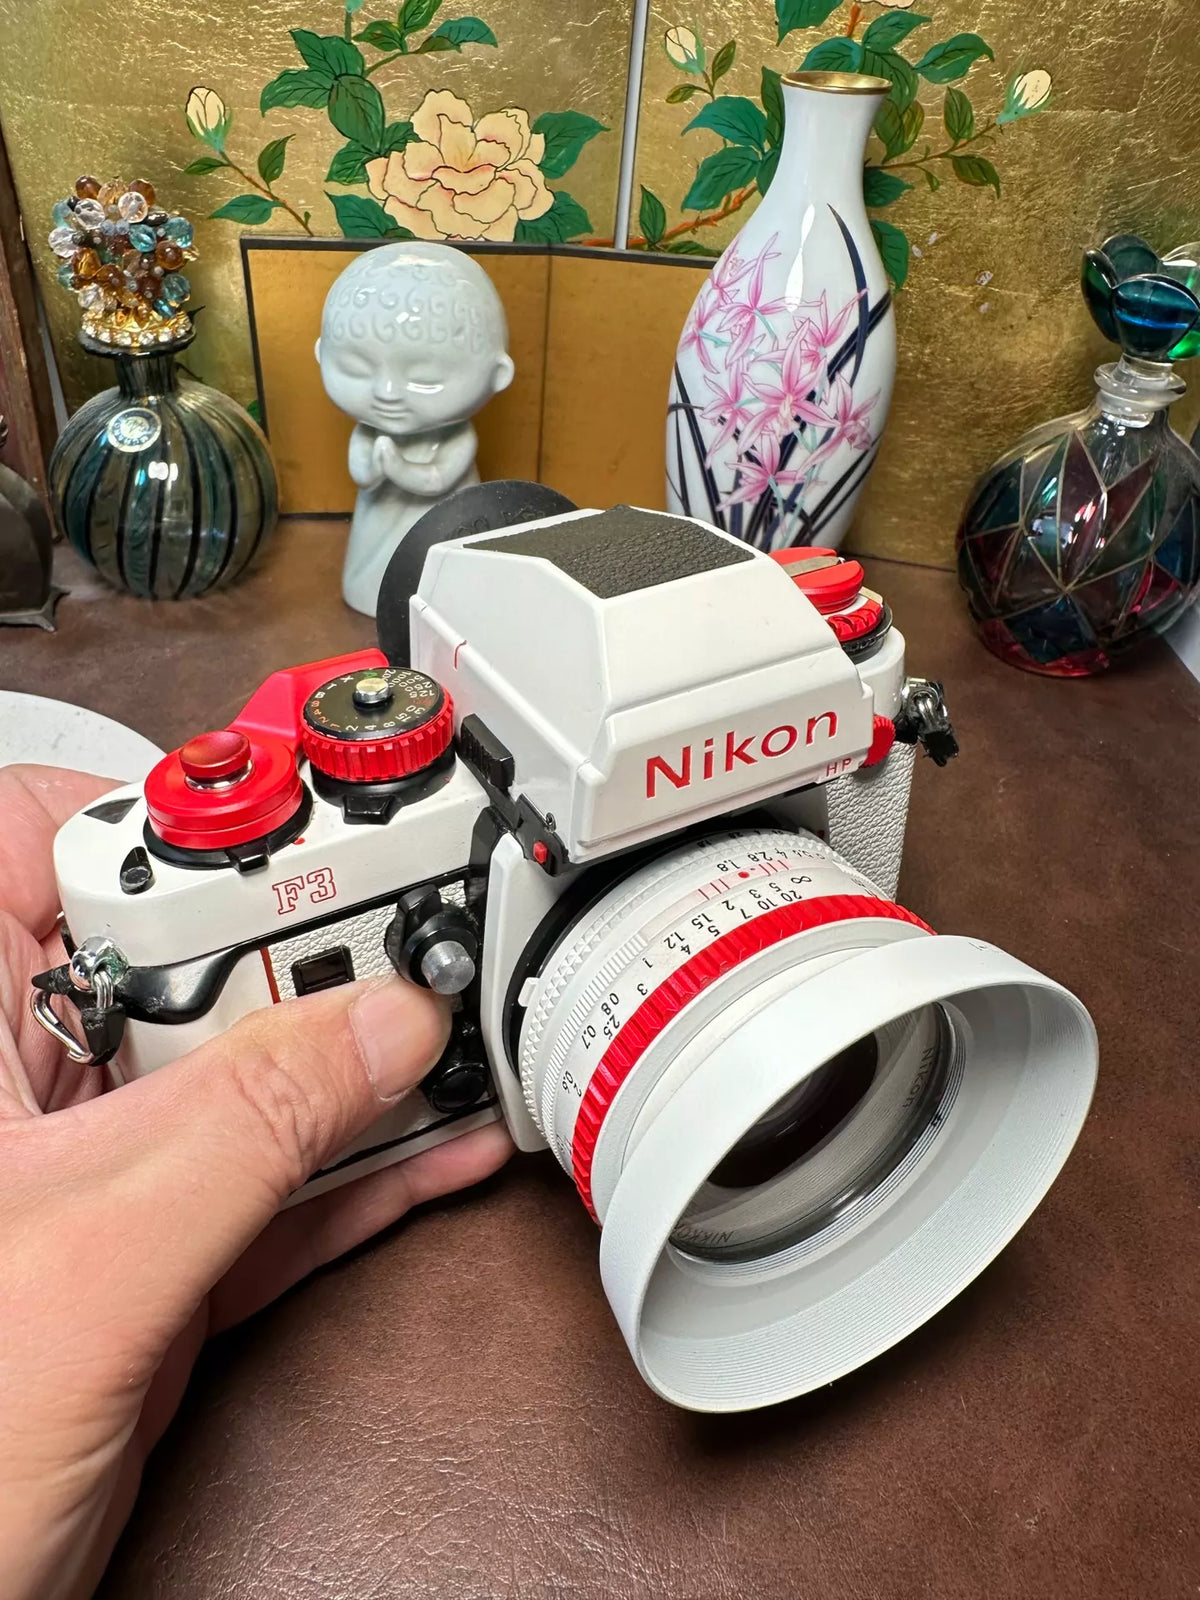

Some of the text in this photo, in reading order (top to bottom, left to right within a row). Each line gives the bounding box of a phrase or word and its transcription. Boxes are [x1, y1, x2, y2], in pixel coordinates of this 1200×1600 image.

[340, 675, 354, 683] X
[315, 691, 326, 699] B
[395, 712, 411, 723] 15
[405, 705, 426, 715] 30
[646, 711, 839, 799] Nikon
[825, 757, 852, 777] HP
[717, 859, 741, 871] 1.8
[747, 851, 773, 862] 2.8
[271, 867, 337, 915] F3
[581, 1025, 597, 1049] 0.7
[664, 932, 686, 949] 1.2
[691, 913, 713, 930] 1.5
[721, 899, 735, 911] 2
[748, 889, 761, 899] 3
[768, 882, 781, 893] 5
[603, 1014, 620, 1040] 2.5
[636, 983, 648, 996] 3
[680, 944, 691, 955] 4
[707, 925, 721, 937] 5
[740, 908, 752, 919] 7
[757, 898, 778, 910] 10
[780, 890, 803, 902] 20
